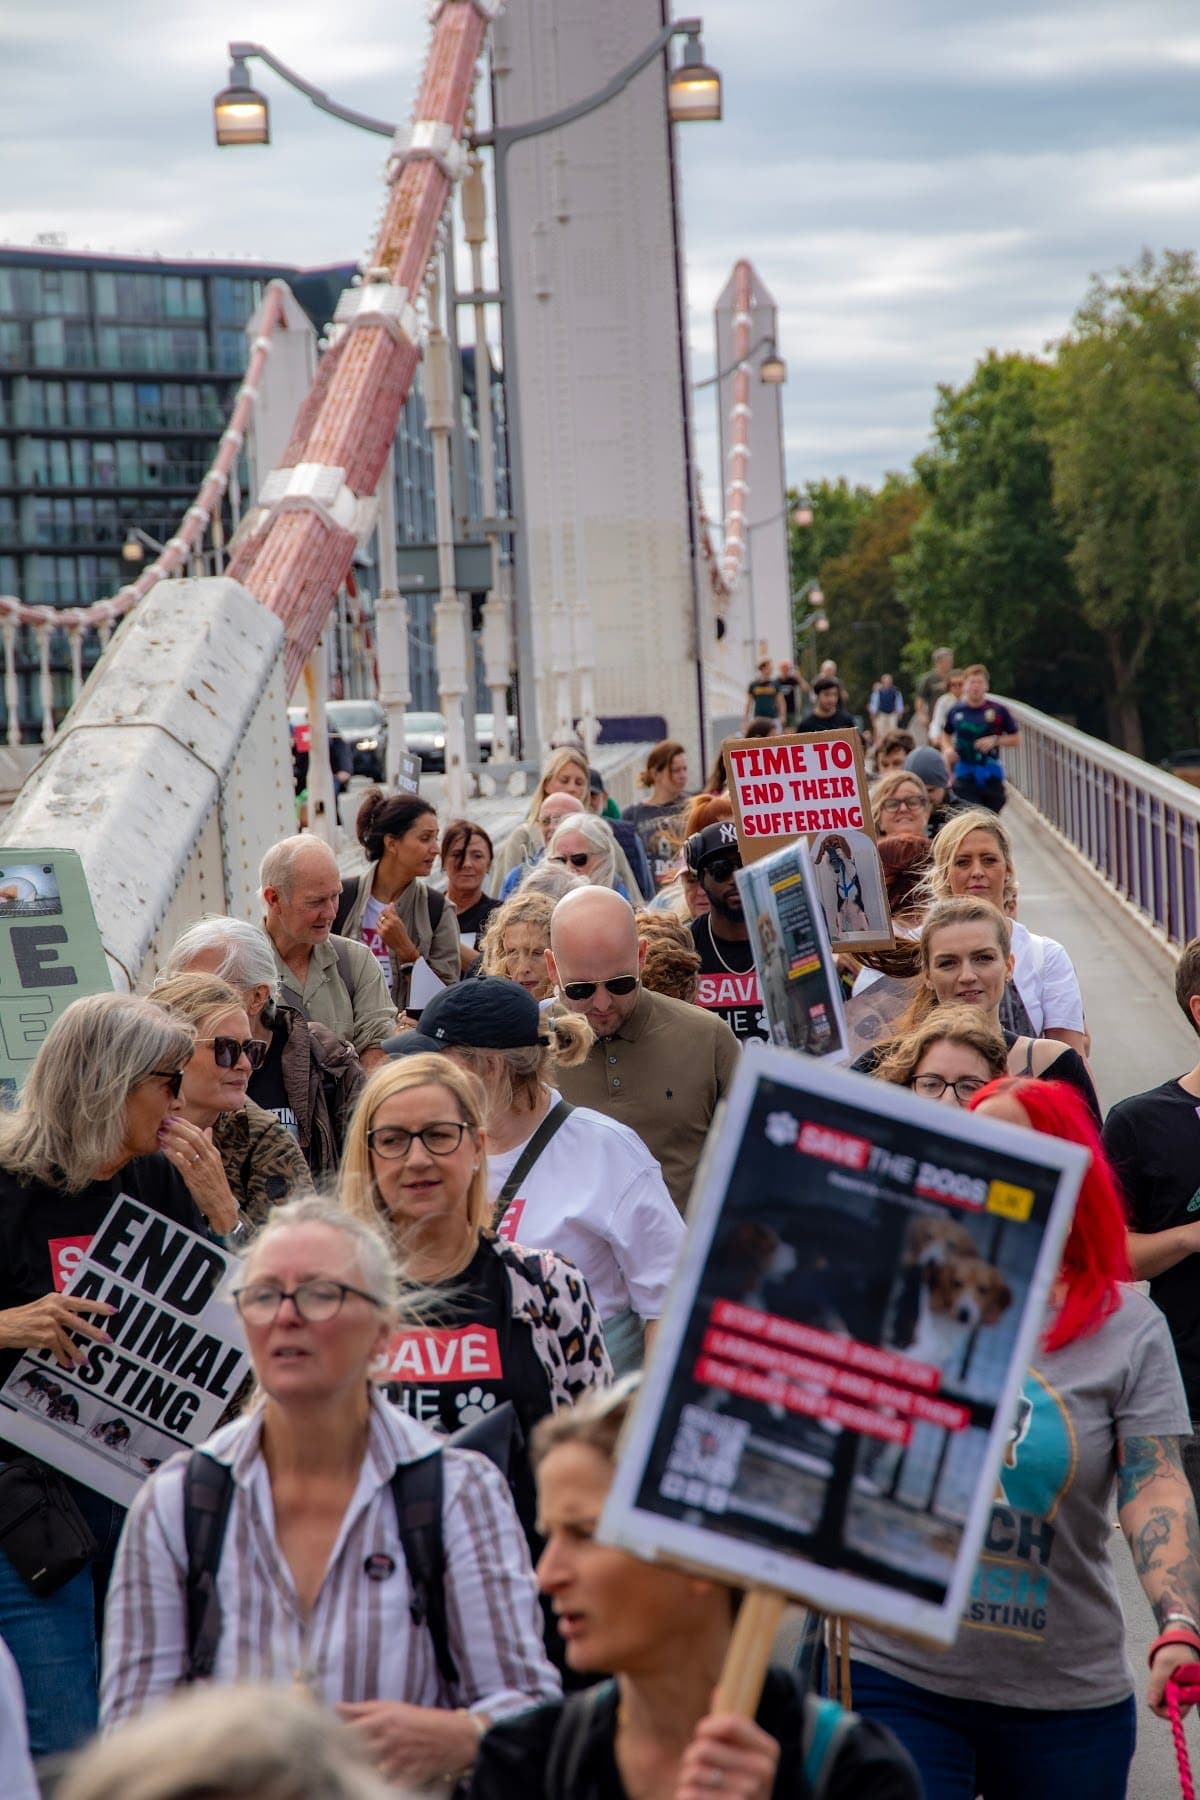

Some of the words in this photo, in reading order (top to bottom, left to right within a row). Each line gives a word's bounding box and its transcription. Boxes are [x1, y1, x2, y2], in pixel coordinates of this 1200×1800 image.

[731, 745, 807, 777] TIME
[813, 741, 853, 771] TO
[741, 782, 784, 805] END
[789, 776, 856, 801] THEIR
[743, 806, 864, 836] SUFFERING
[868, 1147, 915, 1183] THE
[89, 1200, 227, 1316] END
[67, 1270, 242, 1400] ANIMAL
[368, 1333, 491, 1375] AVE
[38, 1327, 200, 1435] STING
[984, 1506, 1056, 1566] CH
[963, 1602, 1047, 1630] STING
